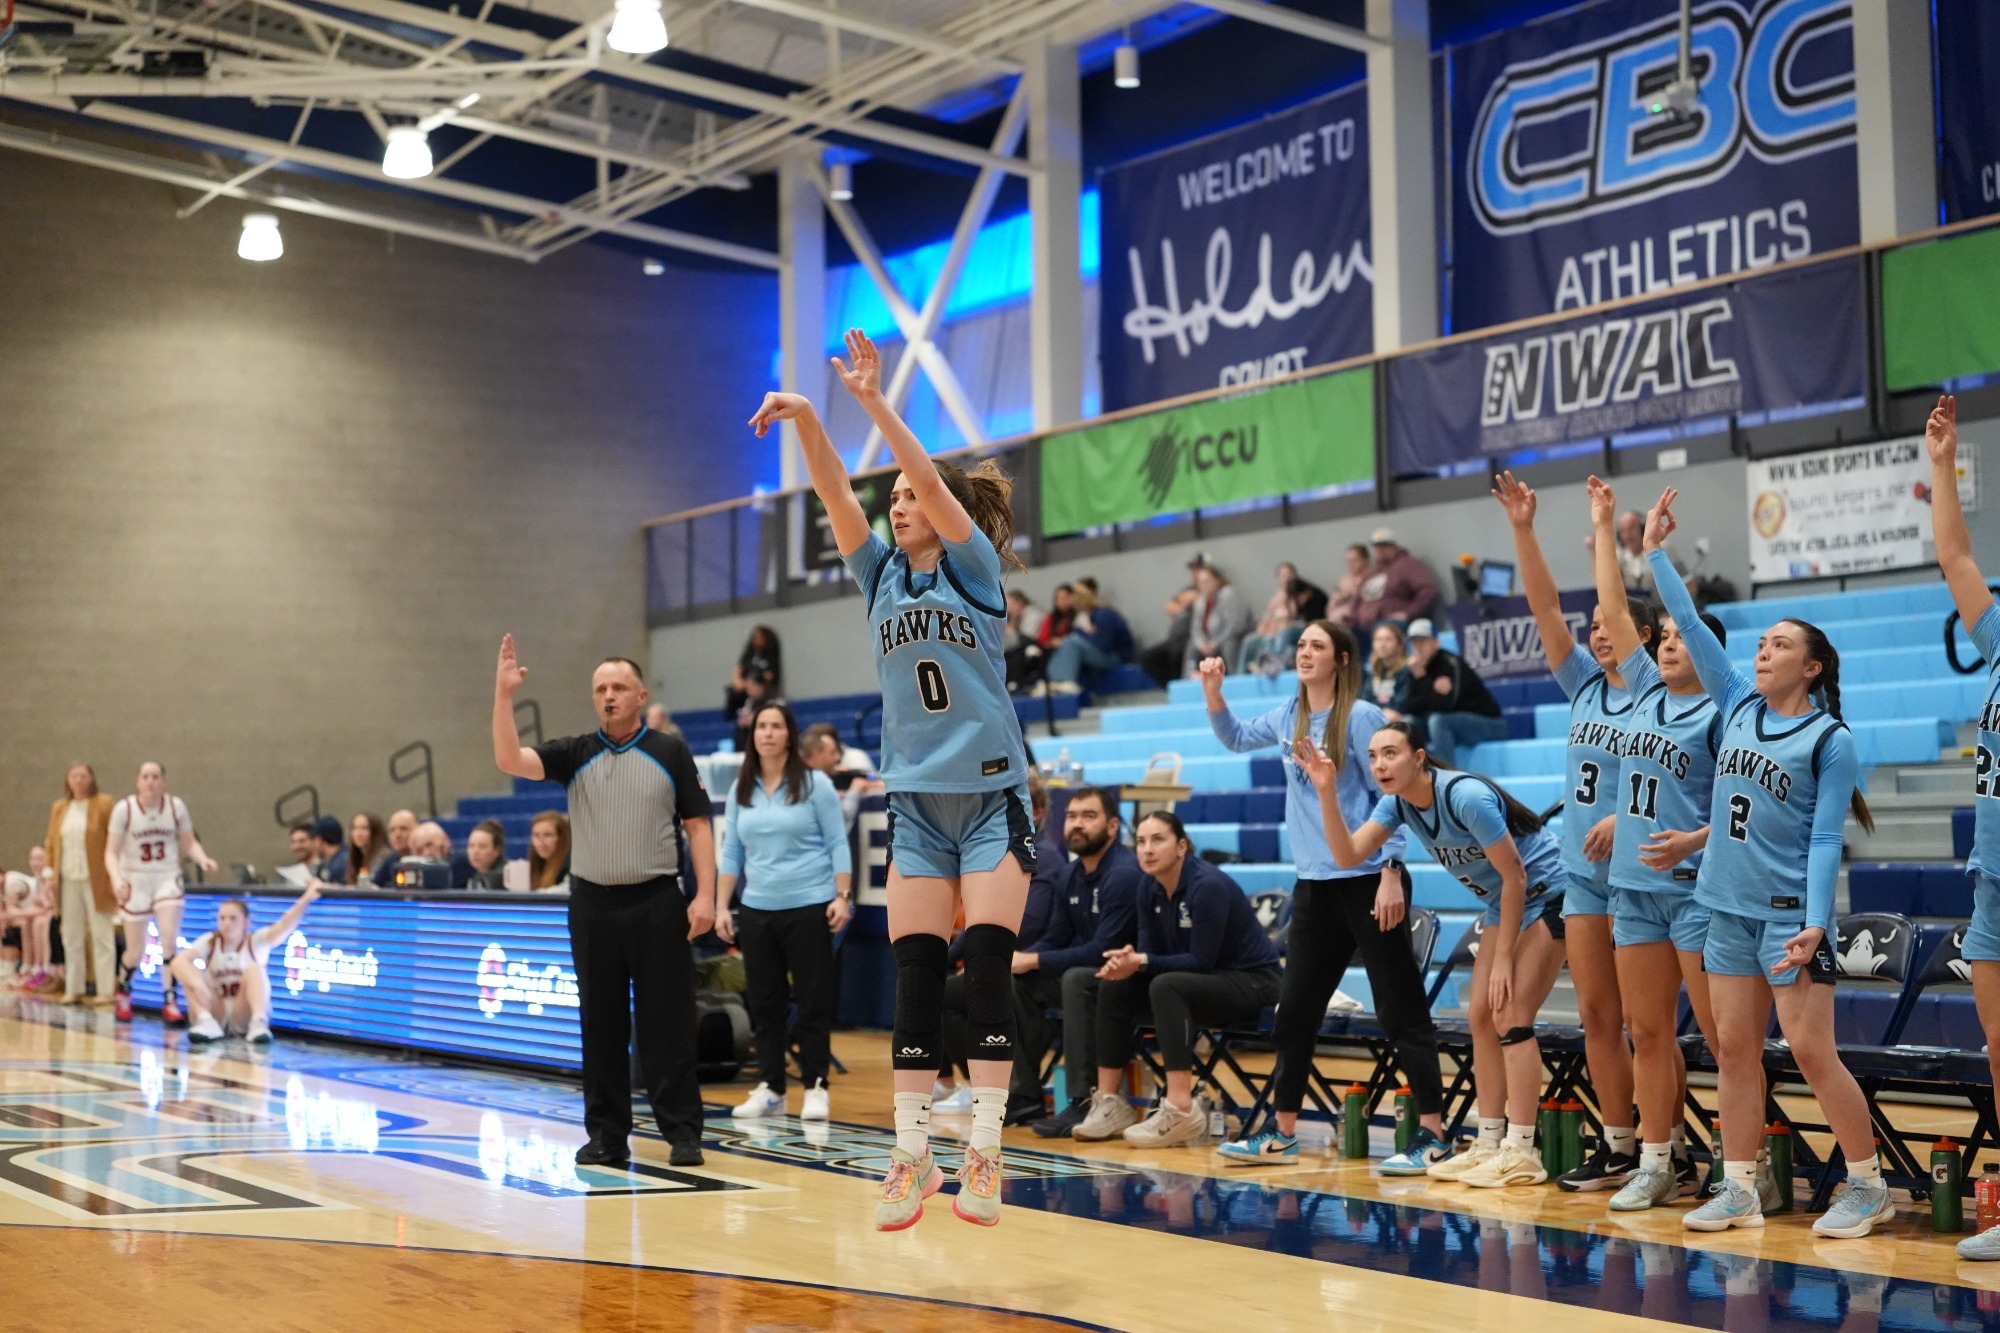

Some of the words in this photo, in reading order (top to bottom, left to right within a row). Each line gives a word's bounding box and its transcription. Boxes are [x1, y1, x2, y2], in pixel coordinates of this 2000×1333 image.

[1466, 0, 1858, 236] CBC
[1178, 131, 1315, 210] WELCOME
[1318, 118, 1356, 165] TO
[1555, 199, 1812, 313] ATHLETICS
[1123, 226, 1374, 365] Holden
[1481, 298, 1740, 427] NWAC
[879, 608, 978, 657] HAWKS
[915, 659, 951, 713] 0
[1568, 721, 1625, 756] HAWK
[1621, 731, 1692, 781] HAWKS
[1575, 760, 1600, 807] 3
[1628, 771, 1660, 823] 11
[1717, 747, 1792, 804] HAWKS
[1728, 793, 1752, 843] 2
[140, 841, 166, 862] 33
